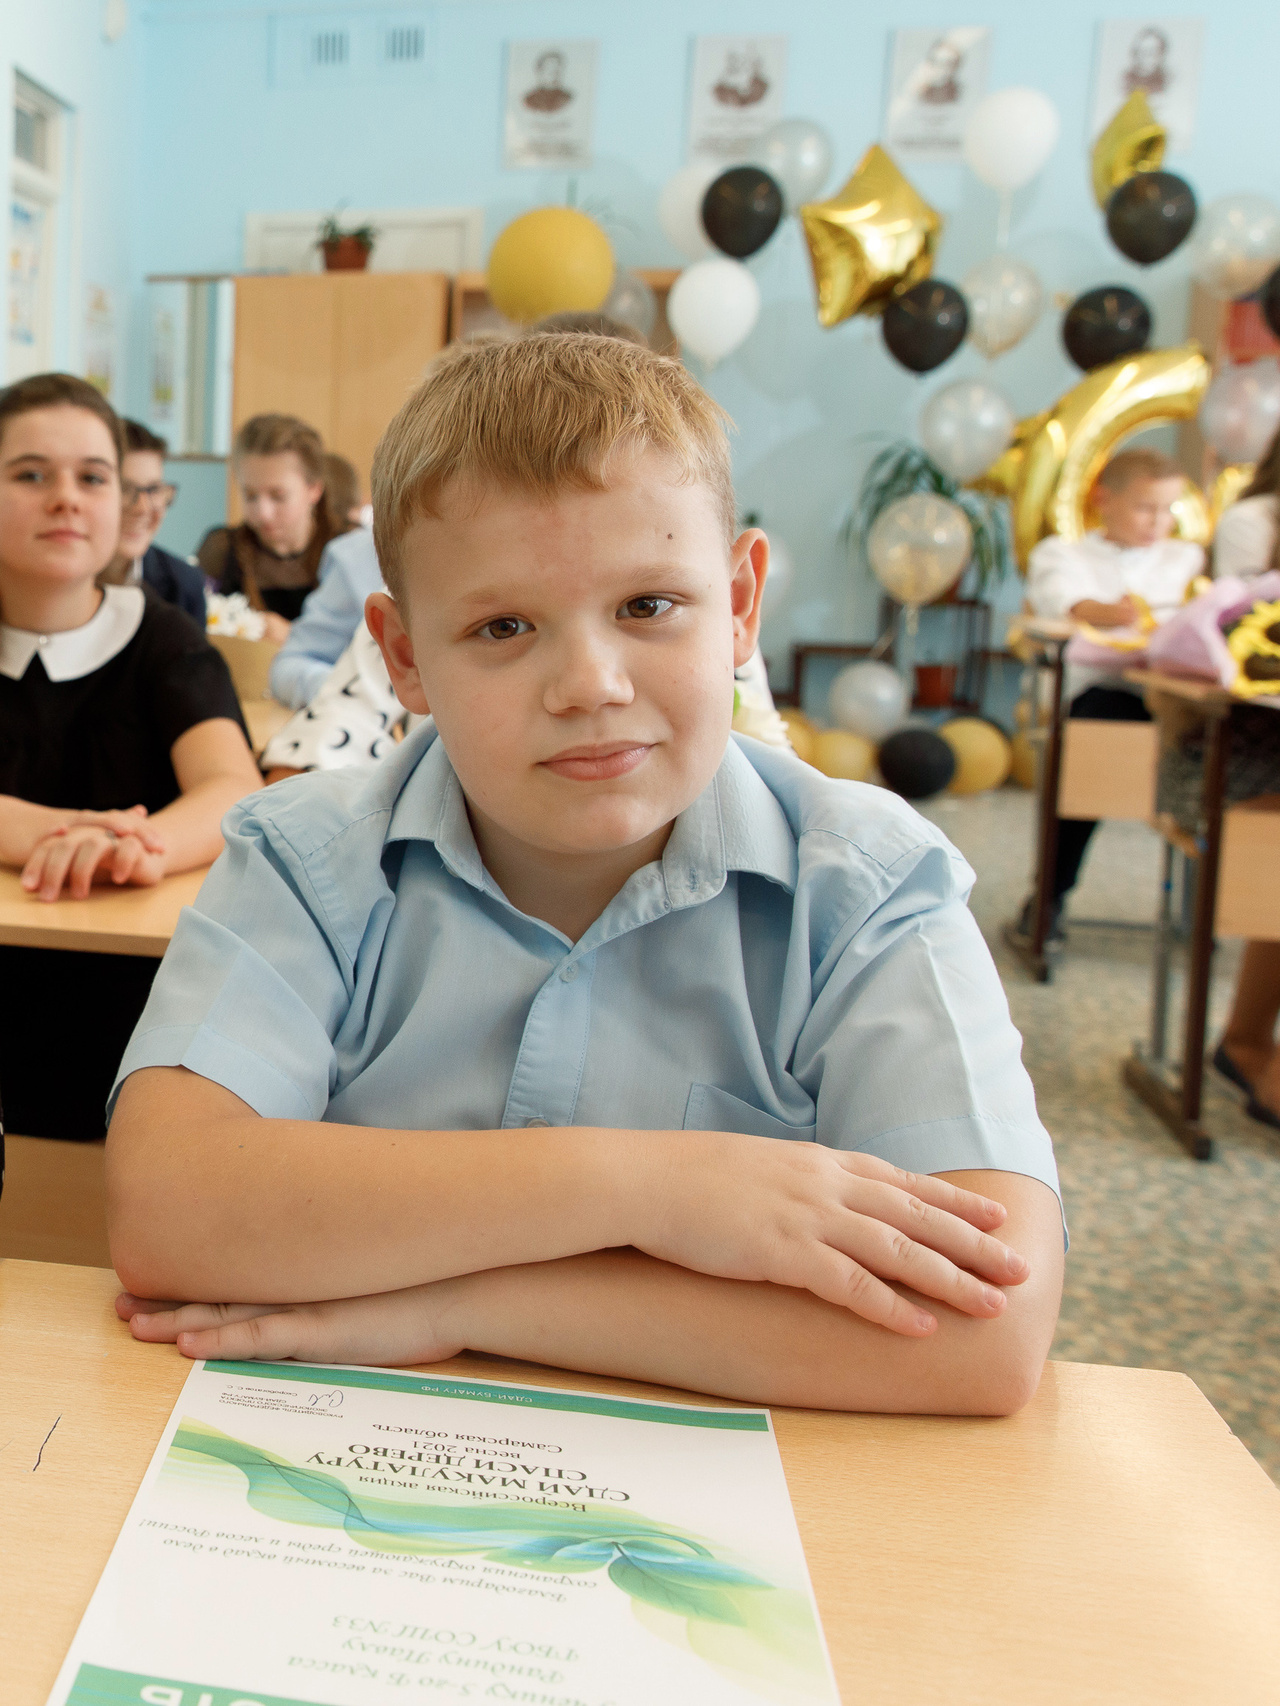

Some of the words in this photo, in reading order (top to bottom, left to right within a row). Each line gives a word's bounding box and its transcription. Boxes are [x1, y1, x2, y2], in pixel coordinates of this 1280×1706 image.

[282, 1408, 343, 1419] РУКОВОДИТЕЛЬ
[372, 1423, 449, 1439] область
[412, 1441, 458, 1454] 2021
[455, 1434, 563, 1454] Самарская
[465, 1446, 521, 1459] весна
[348, 1443, 466, 1467] ДЕРЕВО
[304, 1451, 526, 1490] МАКУЛАТУРУ
[473, 1459, 587, 1481] СПАСИ
[358, 1475, 419, 1490] акция
[538, 1481, 630, 1502] СДАЙ
[426, 1484, 587, 1513] Всероссийская
[137, 1518, 212, 1539] России!
[215, 1531, 265, 1544] лесов
[163, 1538, 203, 1553] дело
[222, 1546, 277, 1563] вклад
[287, 1540, 342, 1554] среды
[282, 1555, 366, 1574] весомый
[348, 1547, 475, 1572] окружающей
[372, 1566, 393, 1576] за
[398, 1570, 436, 1583] Вас
[482, 1565, 597, 1589] сохранения
[442, 1577, 567, 1603] Благодарим
[392, 1624, 477, 1647] СОШ
[342, 1637, 432, 1665] Павлу
[479, 1637, 579, 1662] ГБОУ
[287, 1655, 379, 1680] класса
[439, 1651, 565, 1684] Рандину
[386, 1672, 410, 1687] Б
[485, 1683, 617, 1706] енику
